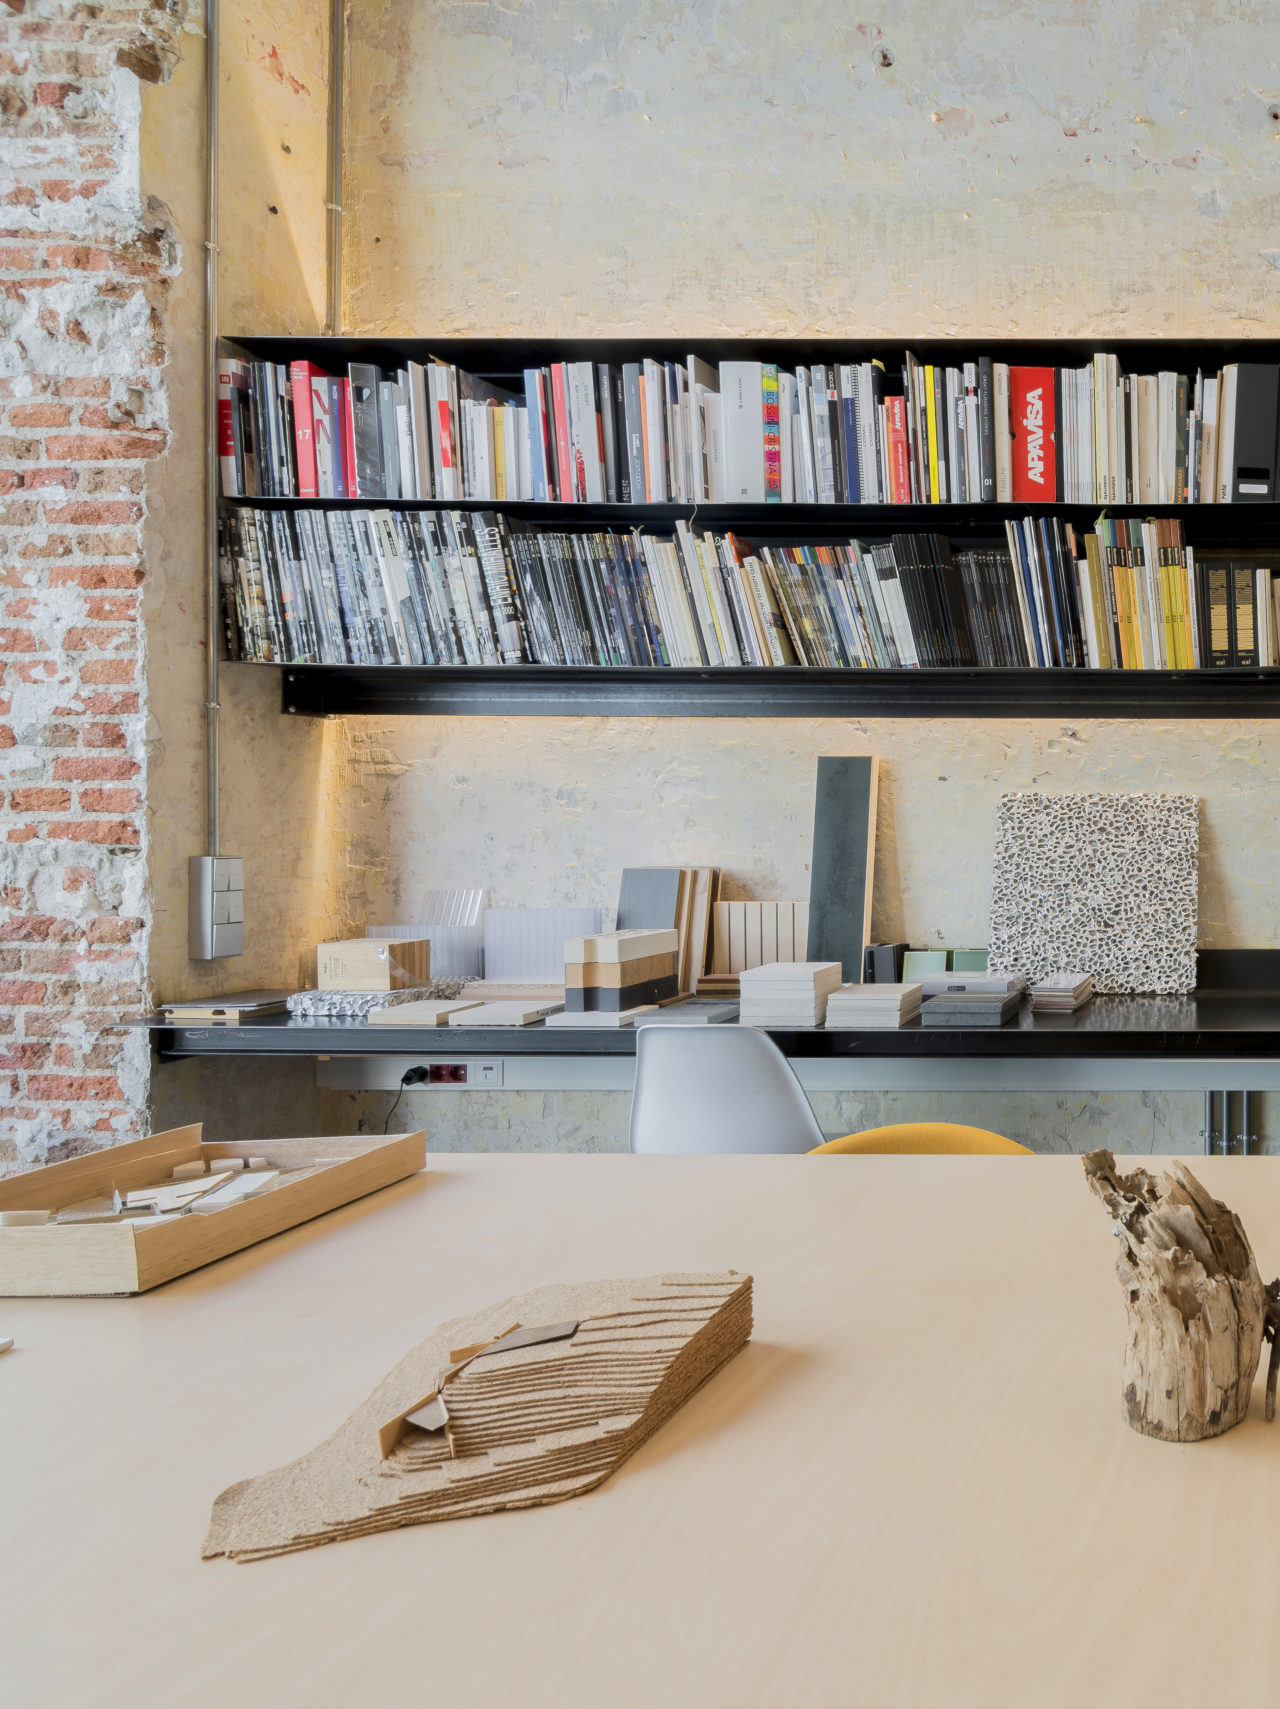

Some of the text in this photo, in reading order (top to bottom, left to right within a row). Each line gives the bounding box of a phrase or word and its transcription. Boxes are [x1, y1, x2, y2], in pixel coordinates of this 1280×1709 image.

[297, 429, 312, 440] 17
[1023, 388, 1045, 485] APAVISA
[475, 526, 506, 575] MIRALLES
